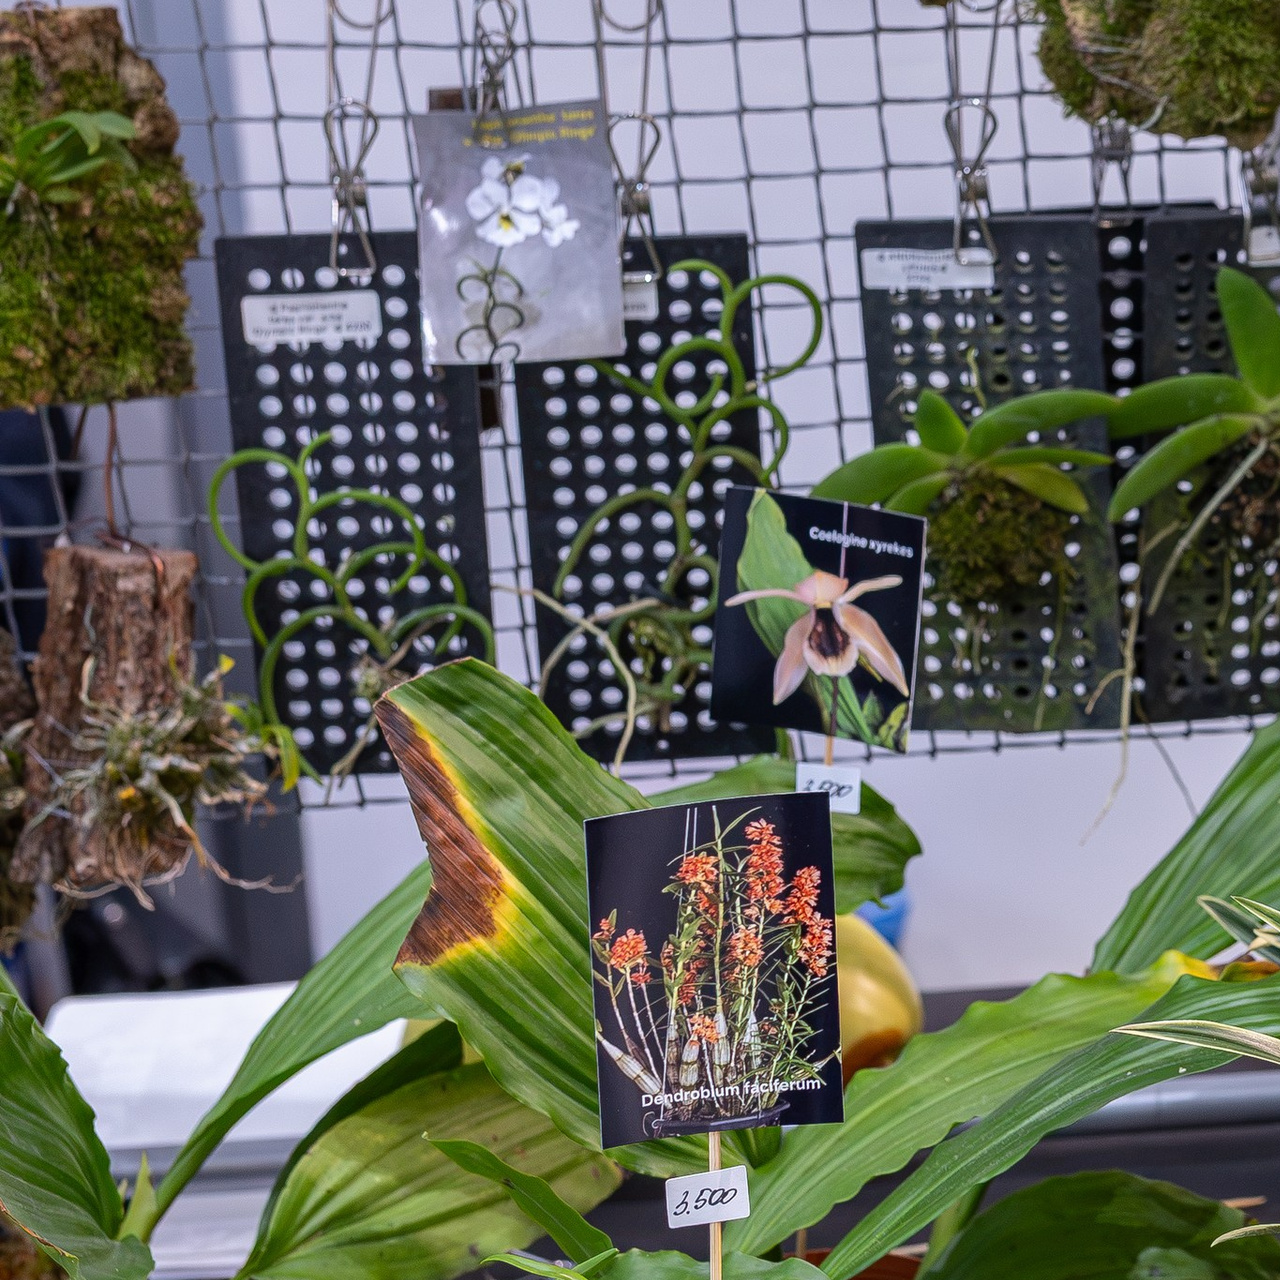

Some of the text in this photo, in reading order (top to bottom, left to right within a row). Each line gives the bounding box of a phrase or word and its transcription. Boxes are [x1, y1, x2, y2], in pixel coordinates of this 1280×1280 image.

[642, 1078, 822, 1108] Dendrobium faciferum
[673, 1187, 737, 1216] 3.500
